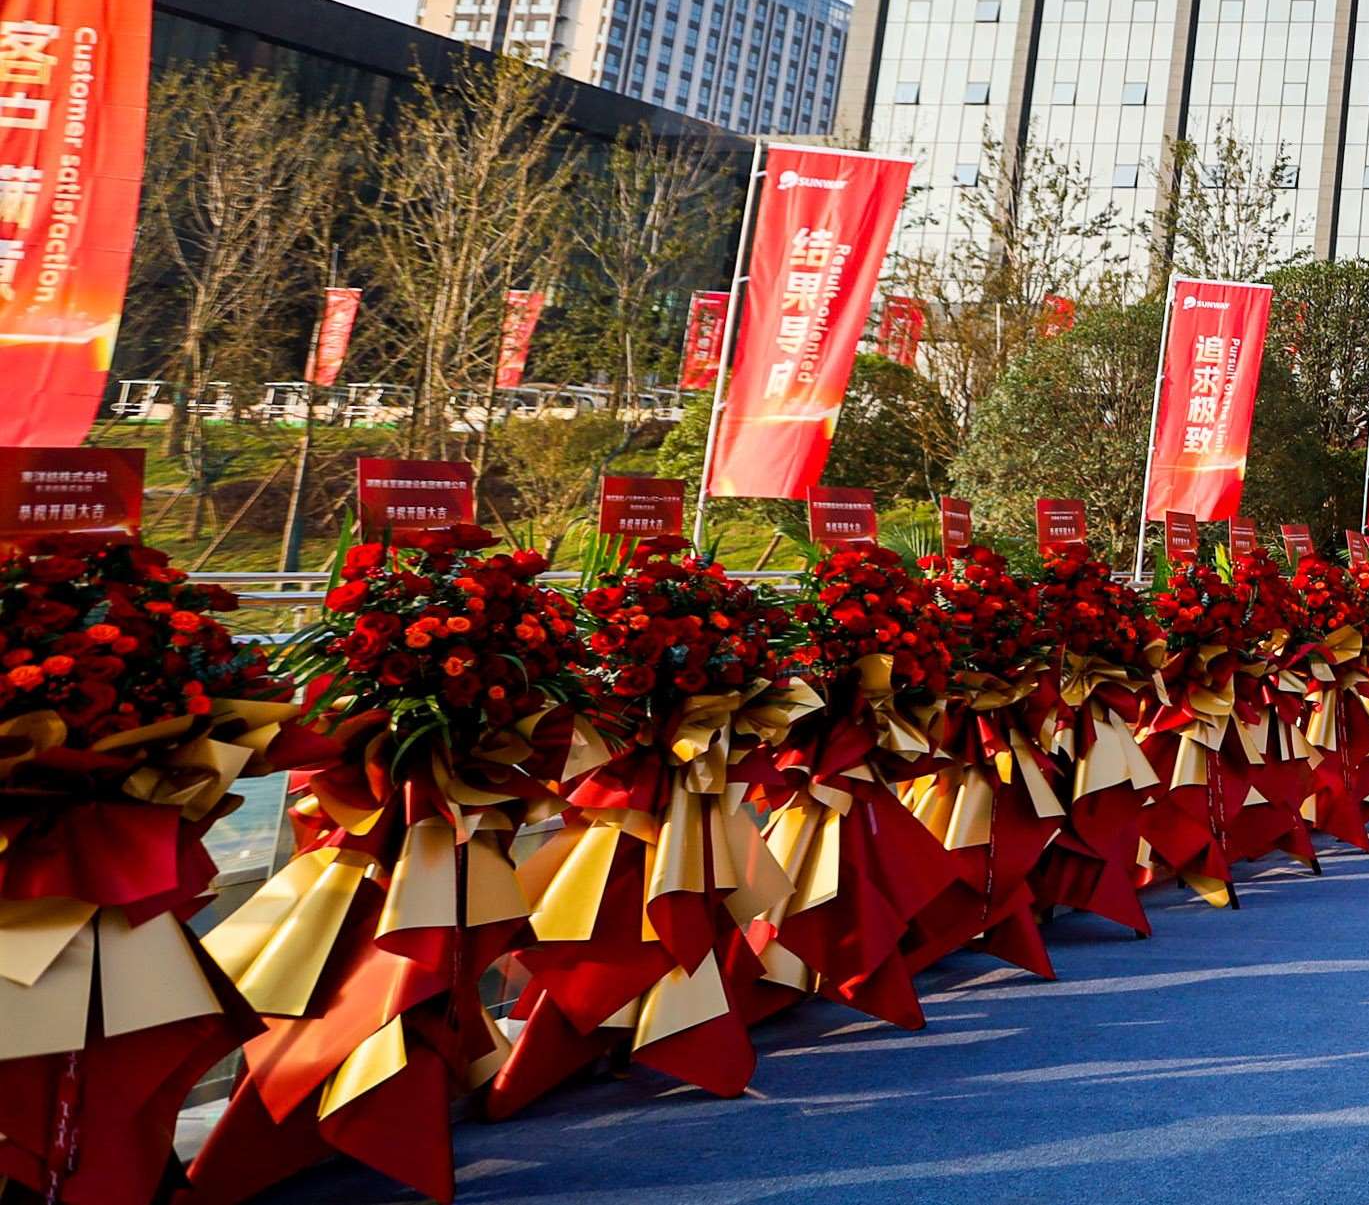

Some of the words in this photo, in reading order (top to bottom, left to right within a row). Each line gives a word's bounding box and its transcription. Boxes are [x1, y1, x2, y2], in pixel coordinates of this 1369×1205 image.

[63, 27, 98, 148] Customer
[33, 154, 82, 302] satisfaction
[797, 243, 852, 383] Result-oriented
[1226, 337, 1241, 381] Pursuit
[1183, 334, 1225, 455] 追求极致
